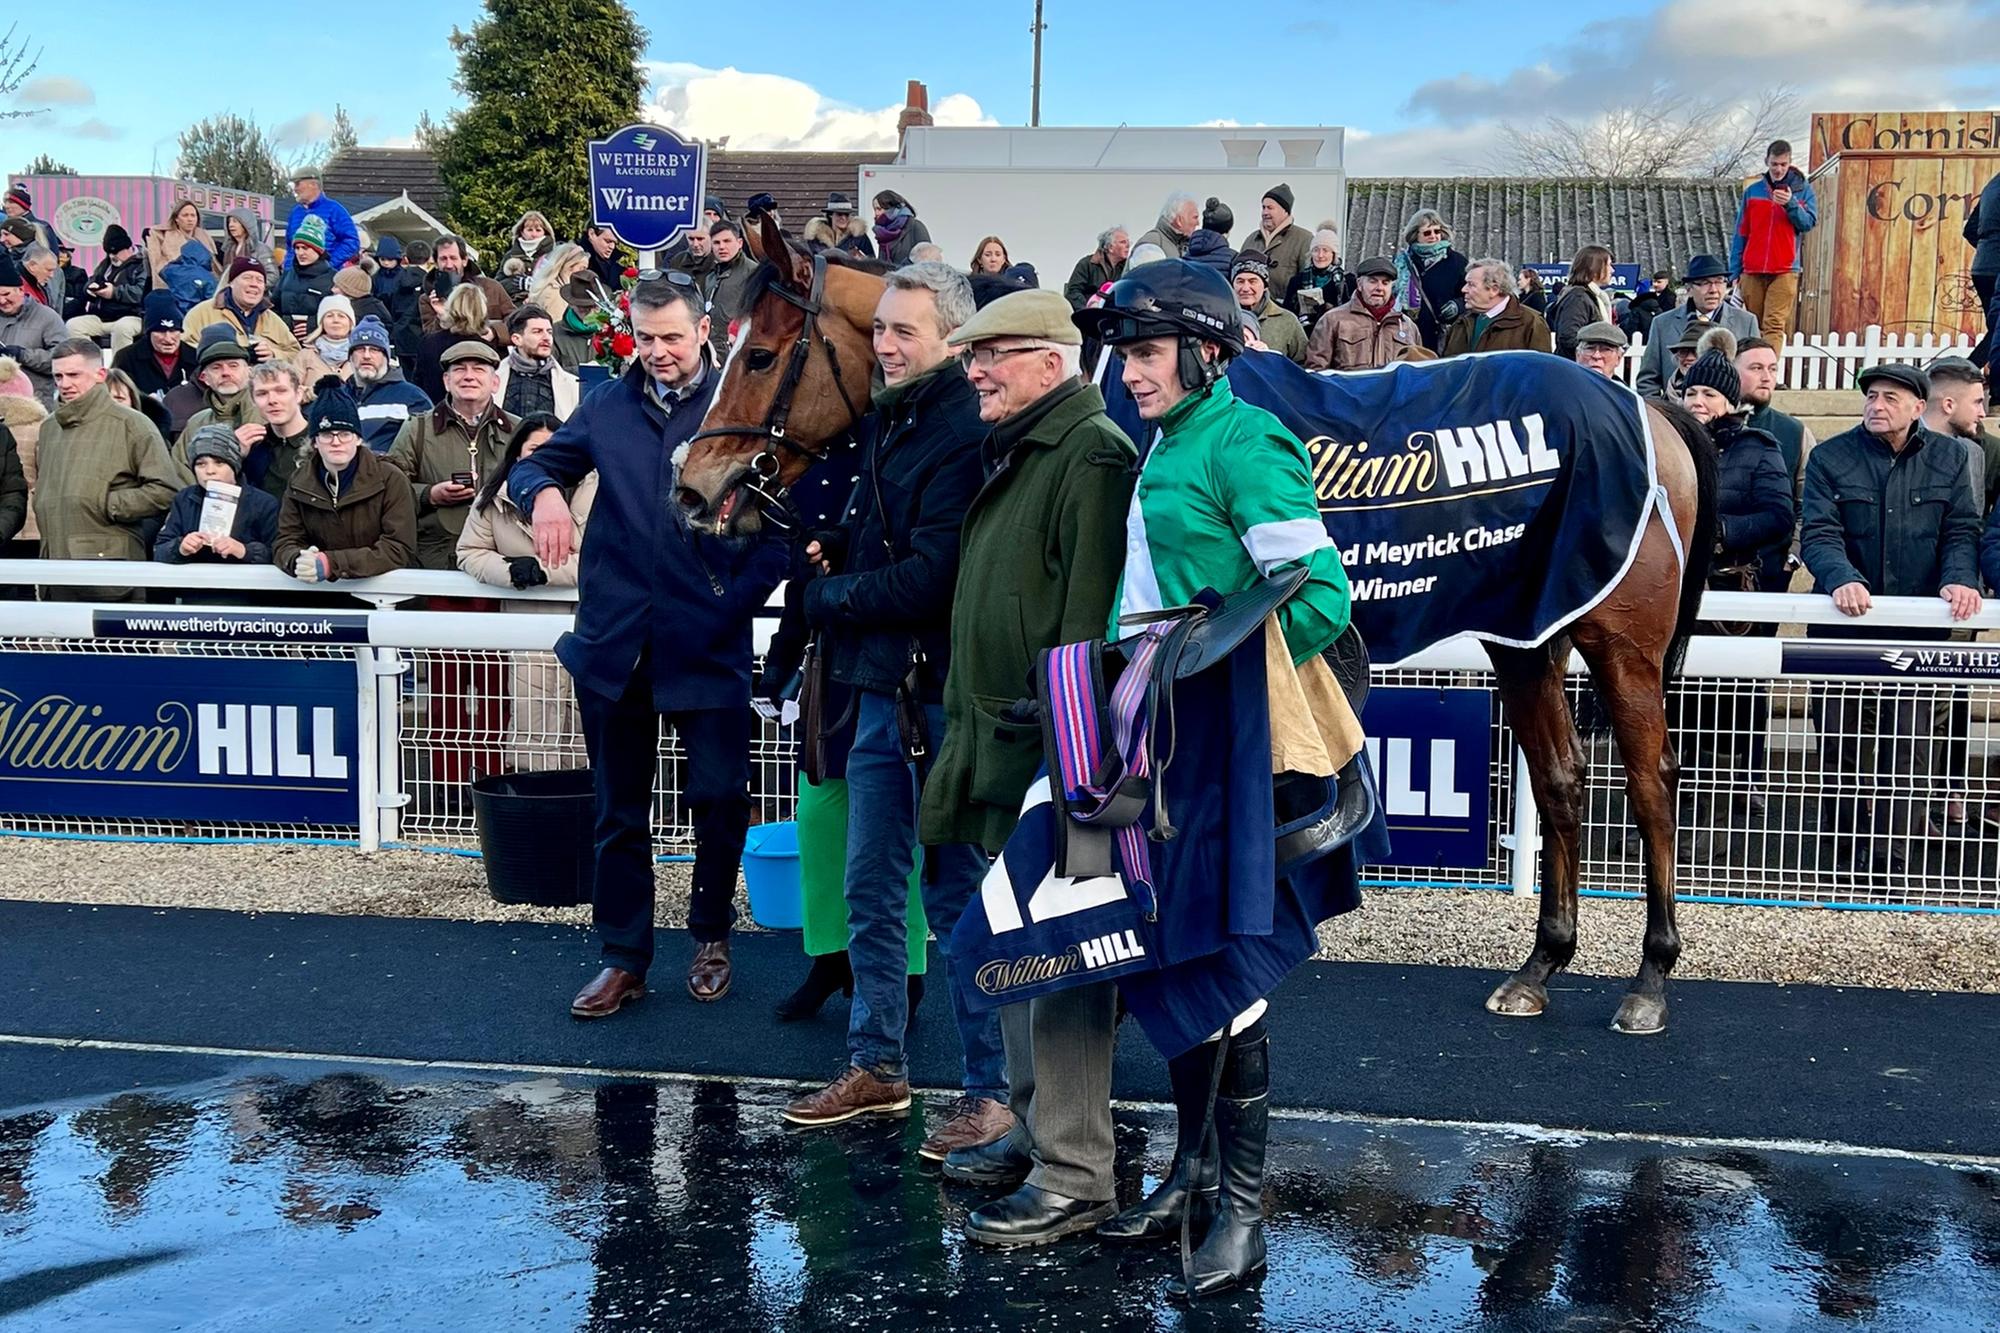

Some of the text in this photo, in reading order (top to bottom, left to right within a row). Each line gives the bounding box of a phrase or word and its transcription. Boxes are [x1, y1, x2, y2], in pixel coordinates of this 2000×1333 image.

[598, 153, 691, 167] WETHERBY
[615, 167, 677, 176] RACECOURSE
[600, 187, 689, 211] Winner
[1435, 413, 1560, 488] HILL
[1365, 531, 1462, 567] Meyrick
[1463, 523, 1526, 552] Chase
[1349, 575, 1437, 602] Winner
[125, 616, 333, 637] www.wetherbyracing.co.uk
[1916, 650, 2000, 667] WETHE
[198, 703, 348, 779] HILL
[975, 929, 1146, 996] William HILL
